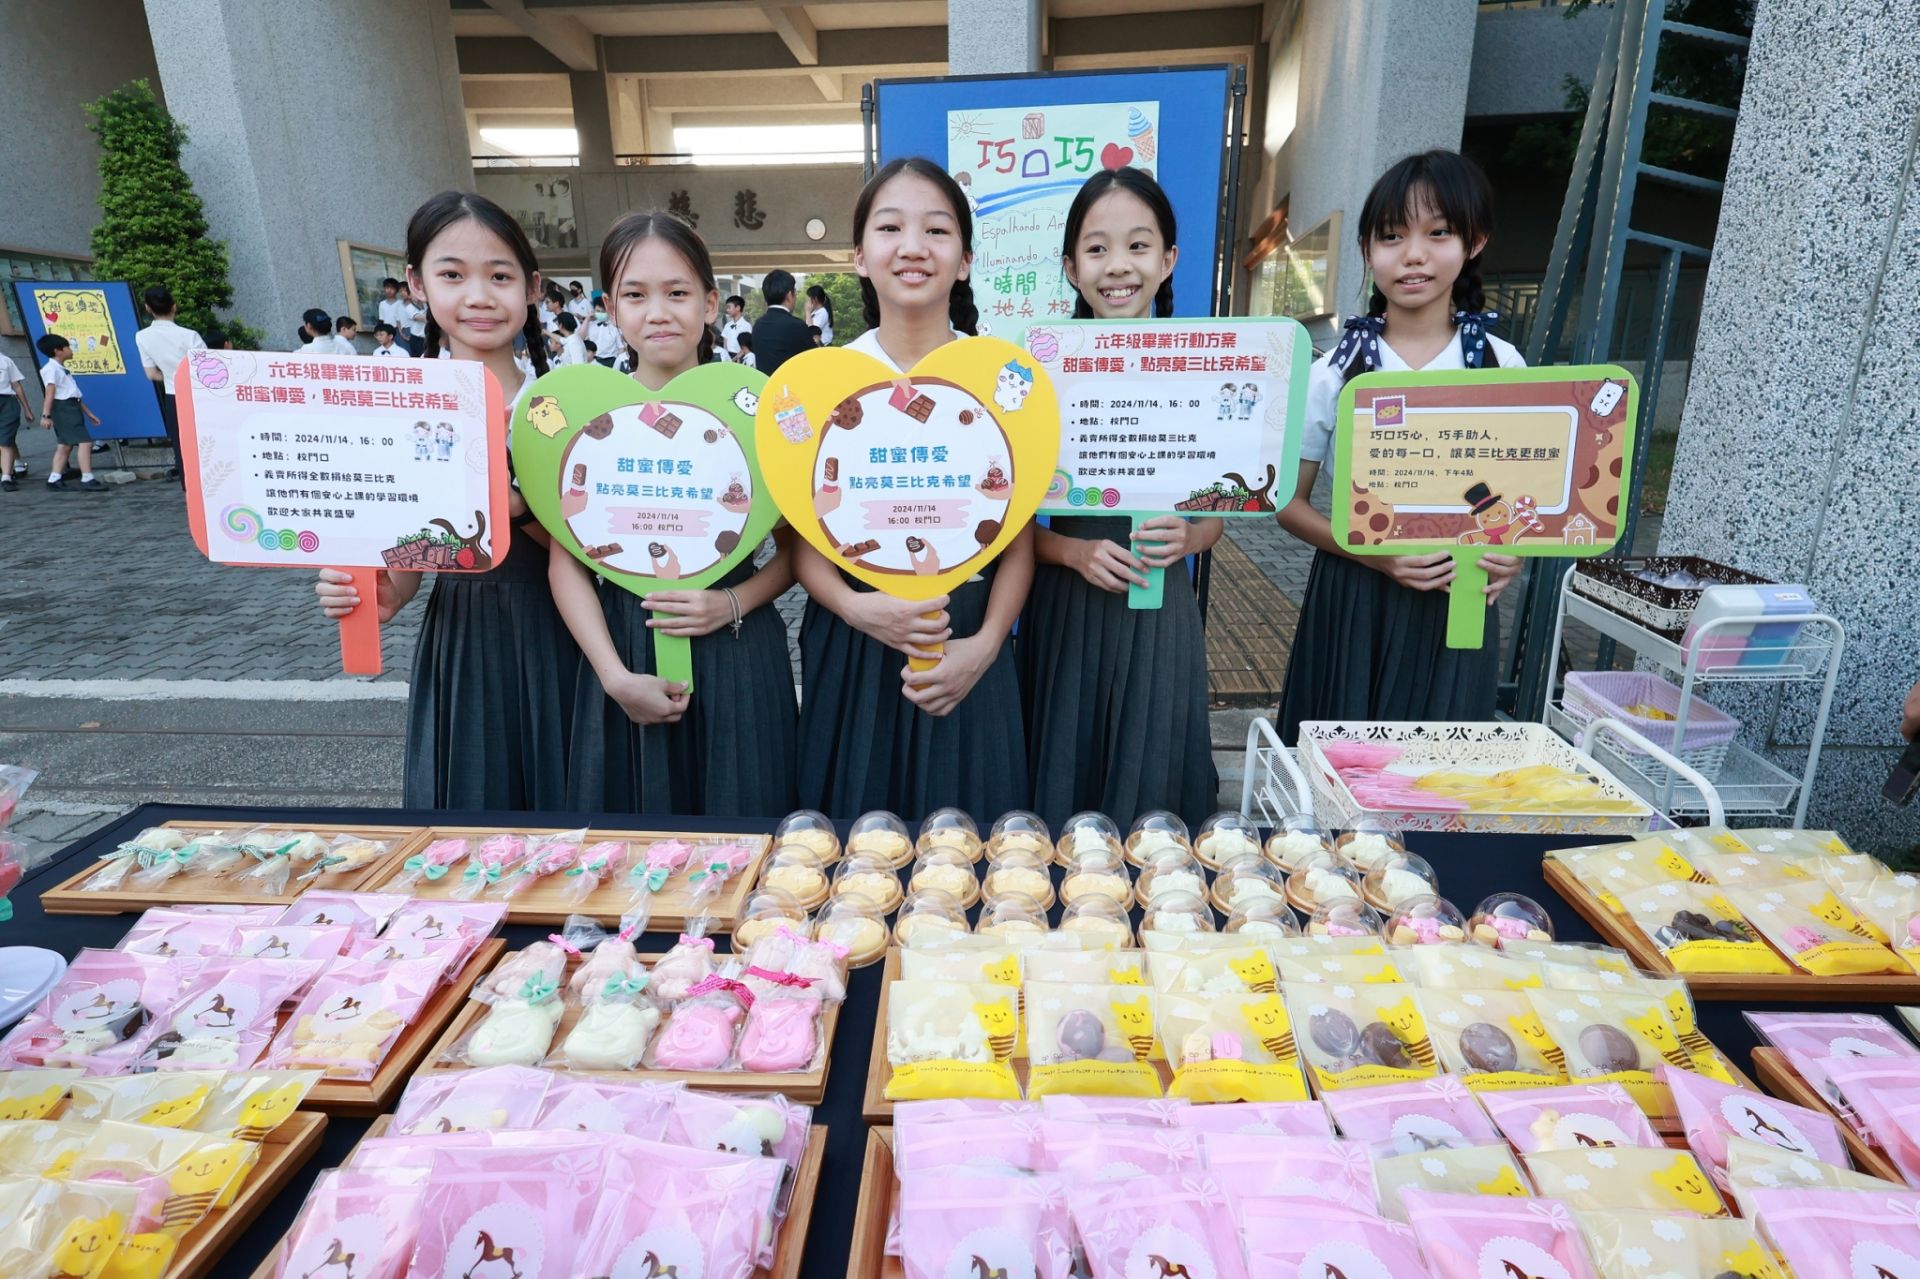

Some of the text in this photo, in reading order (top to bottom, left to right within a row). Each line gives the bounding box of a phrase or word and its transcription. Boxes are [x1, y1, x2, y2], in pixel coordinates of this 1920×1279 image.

[981, 213, 1067, 250] Espalhando Am
[994, 266, 1036, 296] 時間
[1079, 433, 1197, 443] 義賣所得全數捐給莫三比克
[869, 445, 949, 464] 甜蜜傳愛
[1078, 450, 1217, 460] 讓他們有個安心上課的學習環境
[616, 457, 694, 476] 甜蜜傳愛
[1078, 467, 1156, 477] 歡迎大家共襄盛舉
[264, 469, 396, 484] 義賣所得全數捐給莫三比克
[849, 474, 972, 489] 點亮莫三比克希望
[265, 488, 419, 503] 讓他們有個安心上課的學習環境
[595, 482, 714, 501] 點亮莫三比克希望
[267, 506, 355, 519] 歡迎大家共襄盛舉
[892, 504, 937, 513] 2024/11/14
[637, 512, 679, 521] 2024/11/14
[887, 516, 910, 525] 16:00
[631, 523, 653, 531] 16:00
